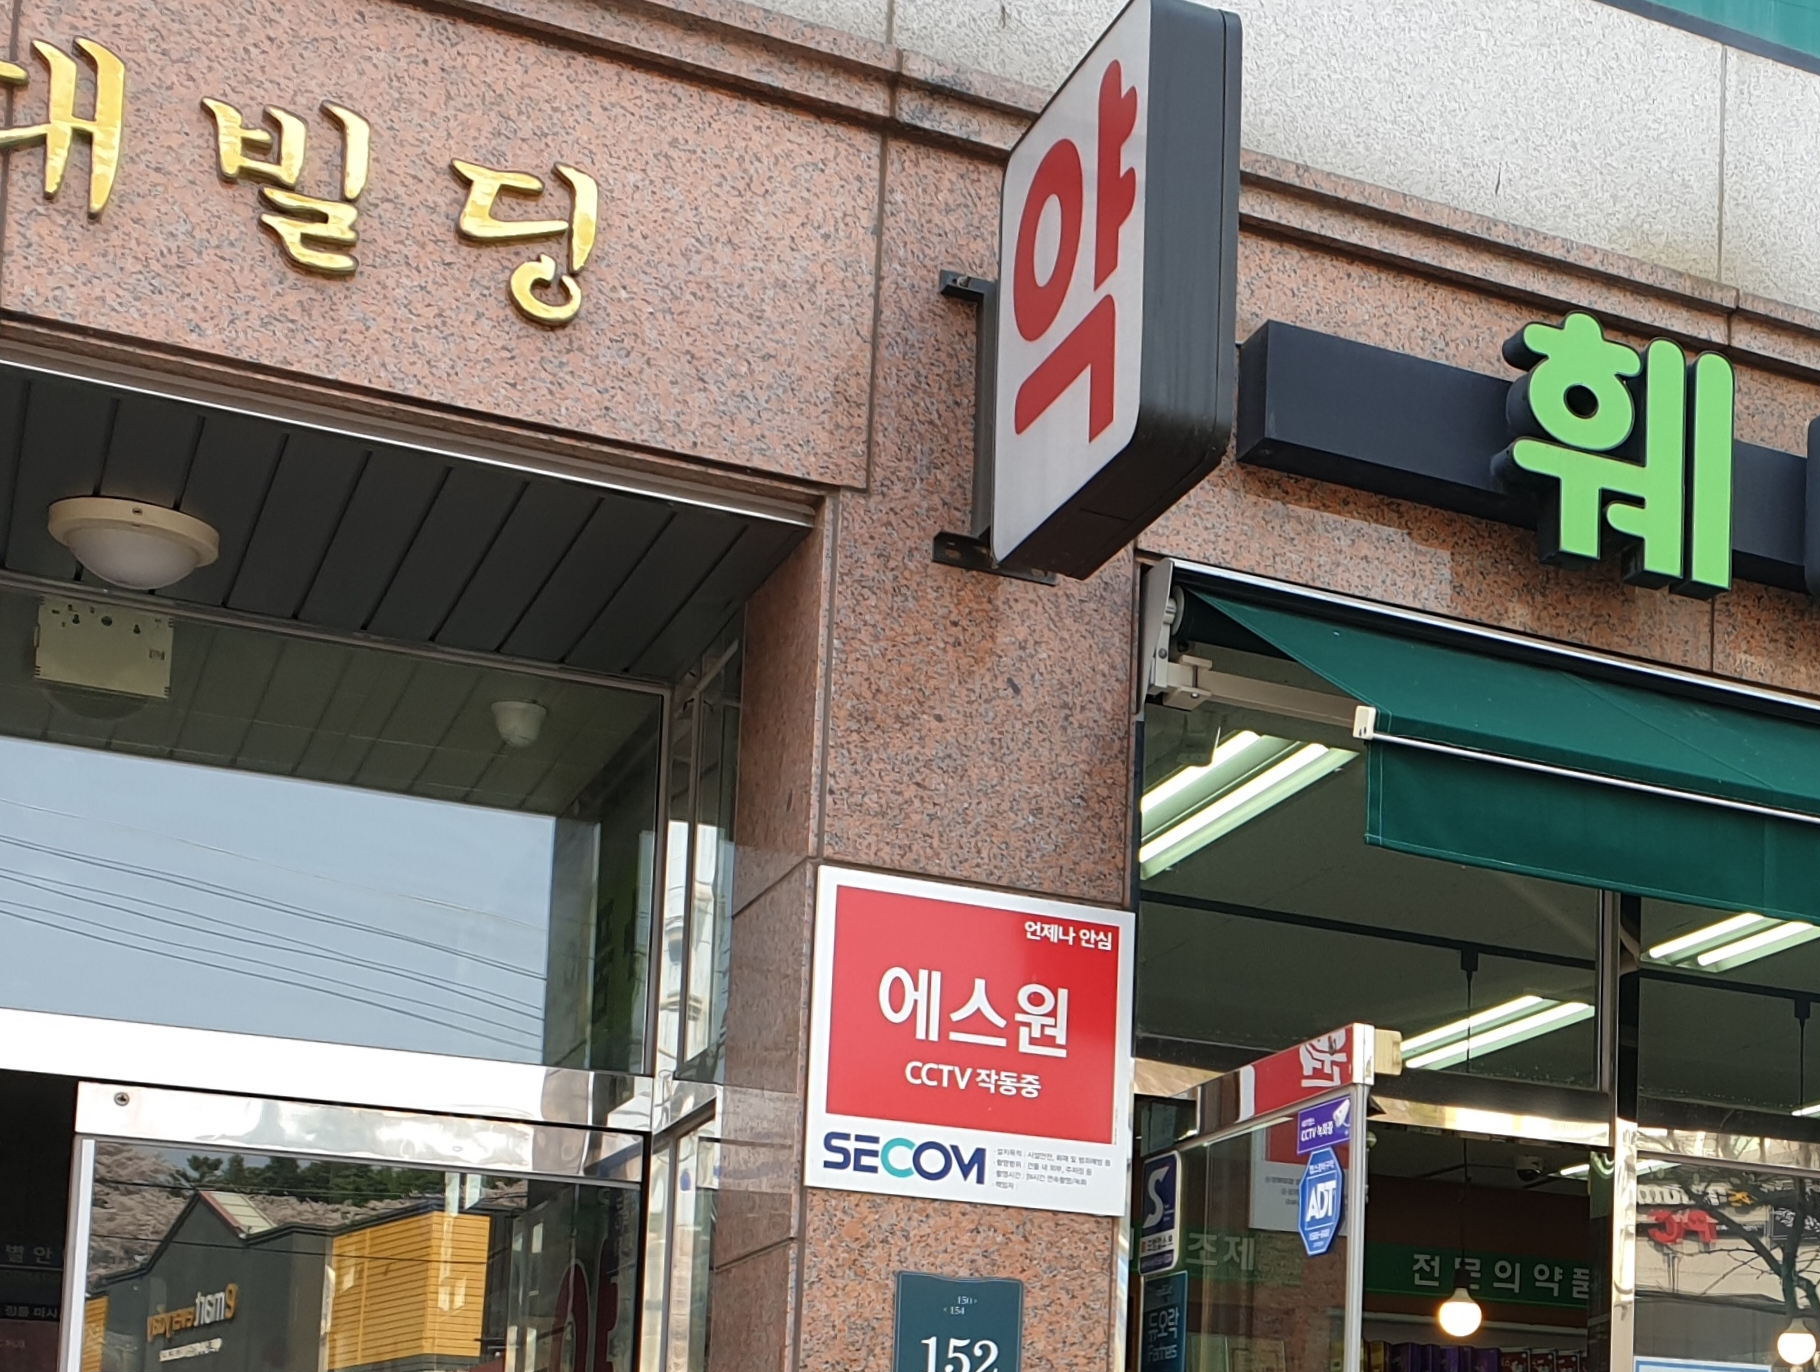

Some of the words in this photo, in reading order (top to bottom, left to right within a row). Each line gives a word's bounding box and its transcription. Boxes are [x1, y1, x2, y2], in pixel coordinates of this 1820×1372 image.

[1015, 59, 1138, 444] 약
[1024, 920, 1076, 946] 언제나
[1079, 926, 1113, 952] 안심
[878, 964, 1070, 1058] 에스원
[904, 1060, 972, 1090] CCTV
[975, 1068, 1042, 1099] 작동중
[1301, 1127, 1316, 1142] CCTV
[822, 1130, 986, 1186] SECOM
[1306, 1181, 1336, 1223] ADT
[950, 1306, 965, 1315] 154
[957, 1296, 973, 1305] 150
